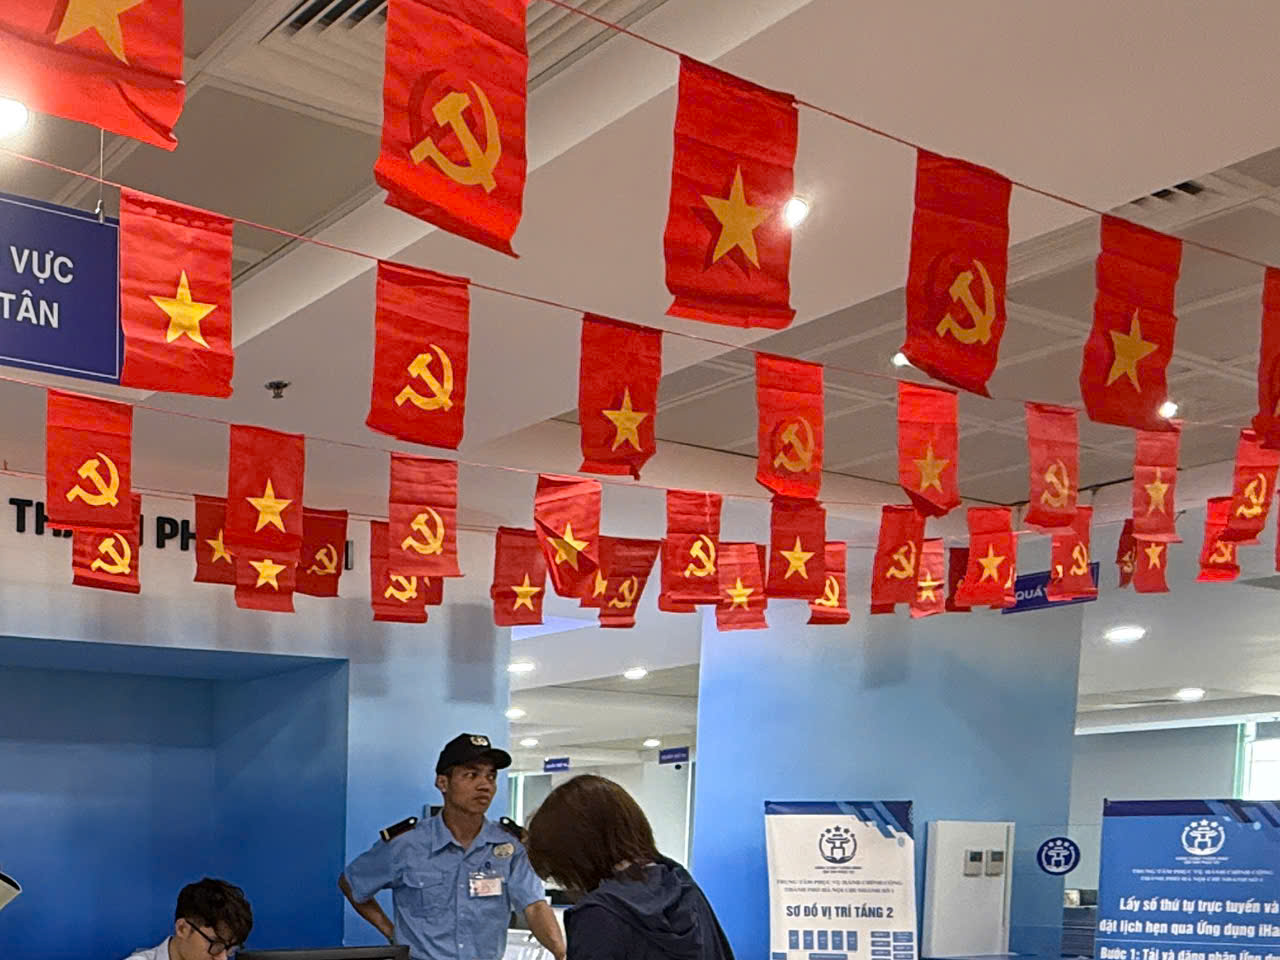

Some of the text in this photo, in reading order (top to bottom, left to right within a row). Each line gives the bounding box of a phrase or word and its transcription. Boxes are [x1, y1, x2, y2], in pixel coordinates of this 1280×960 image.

[10, 246, 74, 284] VỰC
[156, 516, 197, 551] PH
[834, 904, 851, 918] TRÍ
[886, 907, 894, 918] 2
[1259, 924, 1280, 937] iHa
